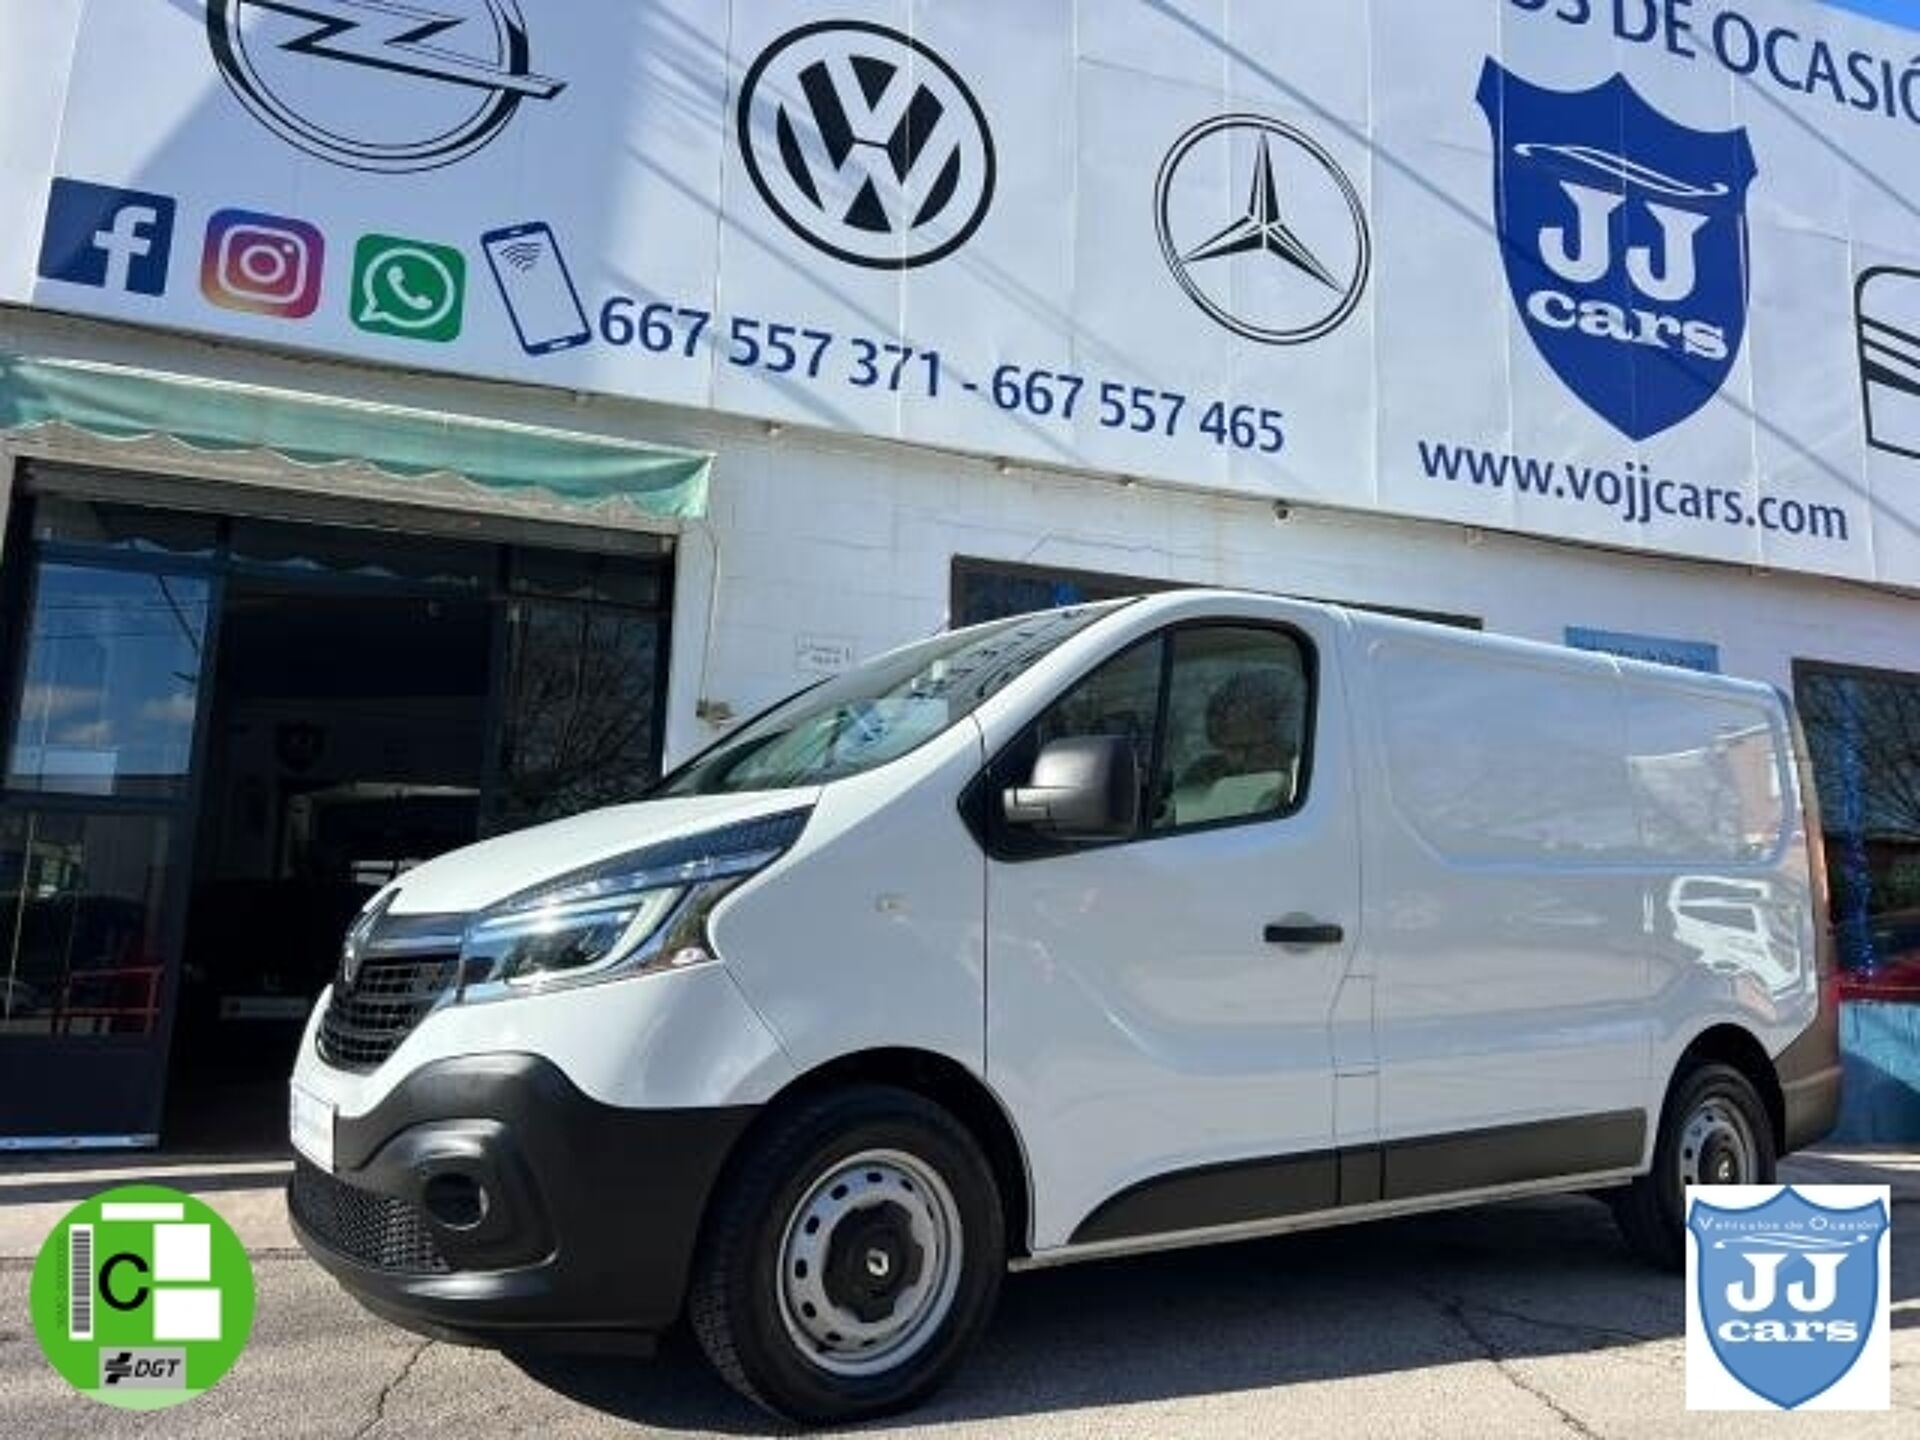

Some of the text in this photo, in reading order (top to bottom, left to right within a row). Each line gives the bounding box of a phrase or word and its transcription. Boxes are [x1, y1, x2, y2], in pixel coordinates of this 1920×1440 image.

[1612, 0, 1696, 59] DE
[1538, 180, 1710, 301] JJ
[599, 296, 711, 358] 667
[728, 317, 833, 378] 557
[848, 338, 940, 398] 371
[992, 364, 1084, 420] 667
[1100, 381, 1186, 437] 557
[1199, 401, 1285, 454] 465
[1526, 290, 1729, 360] cars
[1417, 440, 1849, 541] www.vojjcars.com
